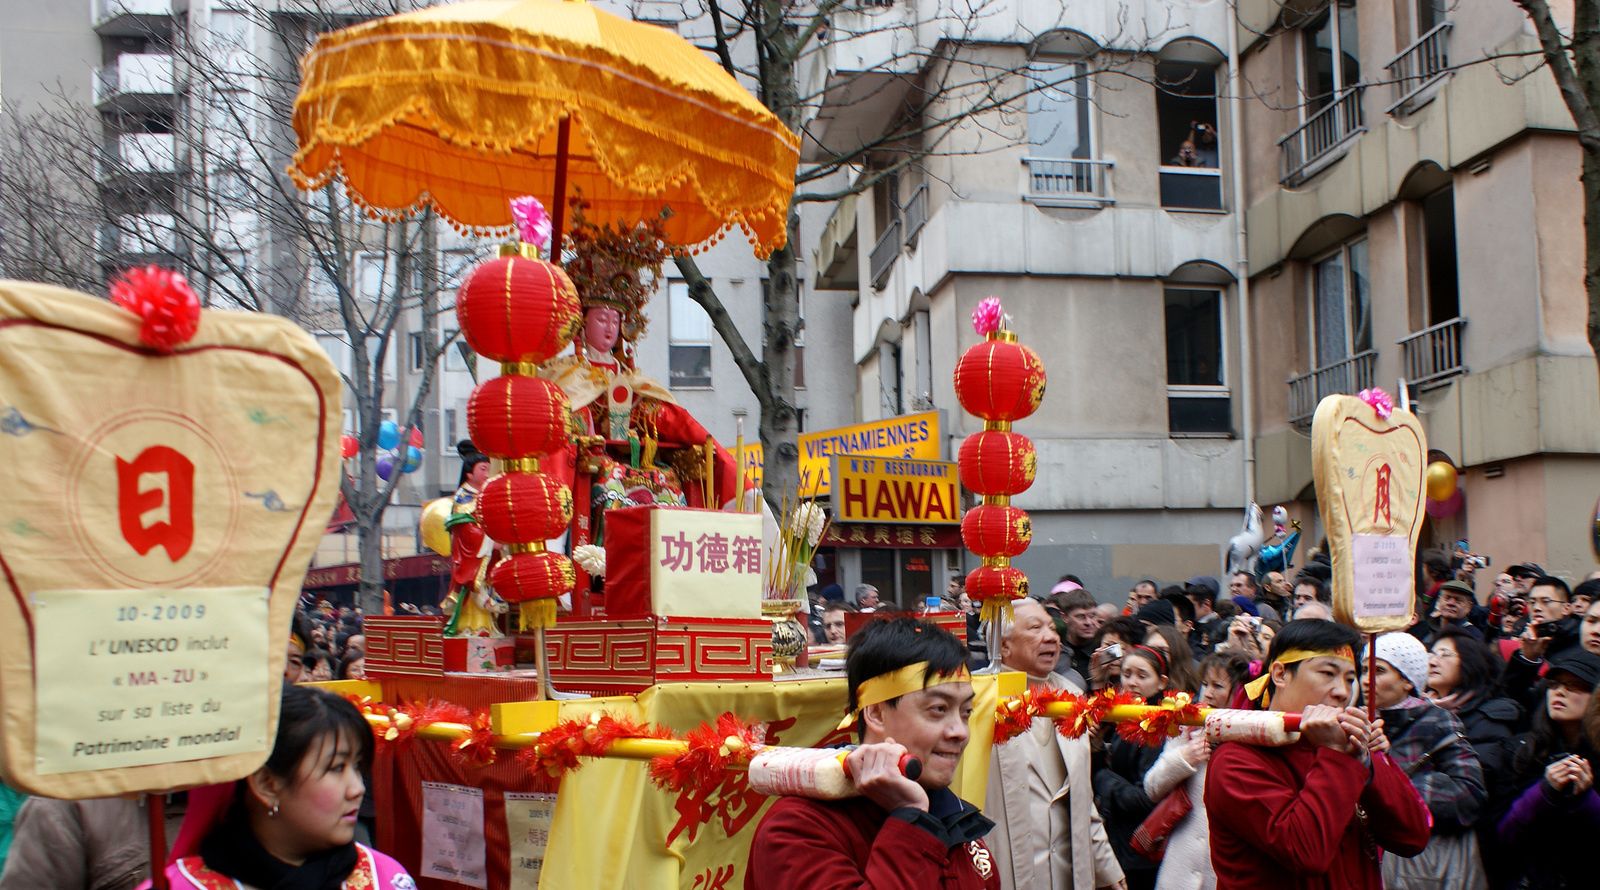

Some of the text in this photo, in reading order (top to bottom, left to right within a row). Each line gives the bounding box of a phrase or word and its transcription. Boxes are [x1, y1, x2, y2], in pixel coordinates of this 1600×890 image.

[806, 420, 929, 459] VIETNAMIENNES
[885, 461, 948, 477] RESTAURANT
[843, 478, 957, 520] HAWAI
[660, 531, 761, 574] 功德箱
[186, 635, 229, 650] inclut
[97, 698, 222, 722] sur sa liste du
[72, 726, 242, 757] Patrimoine mondial
